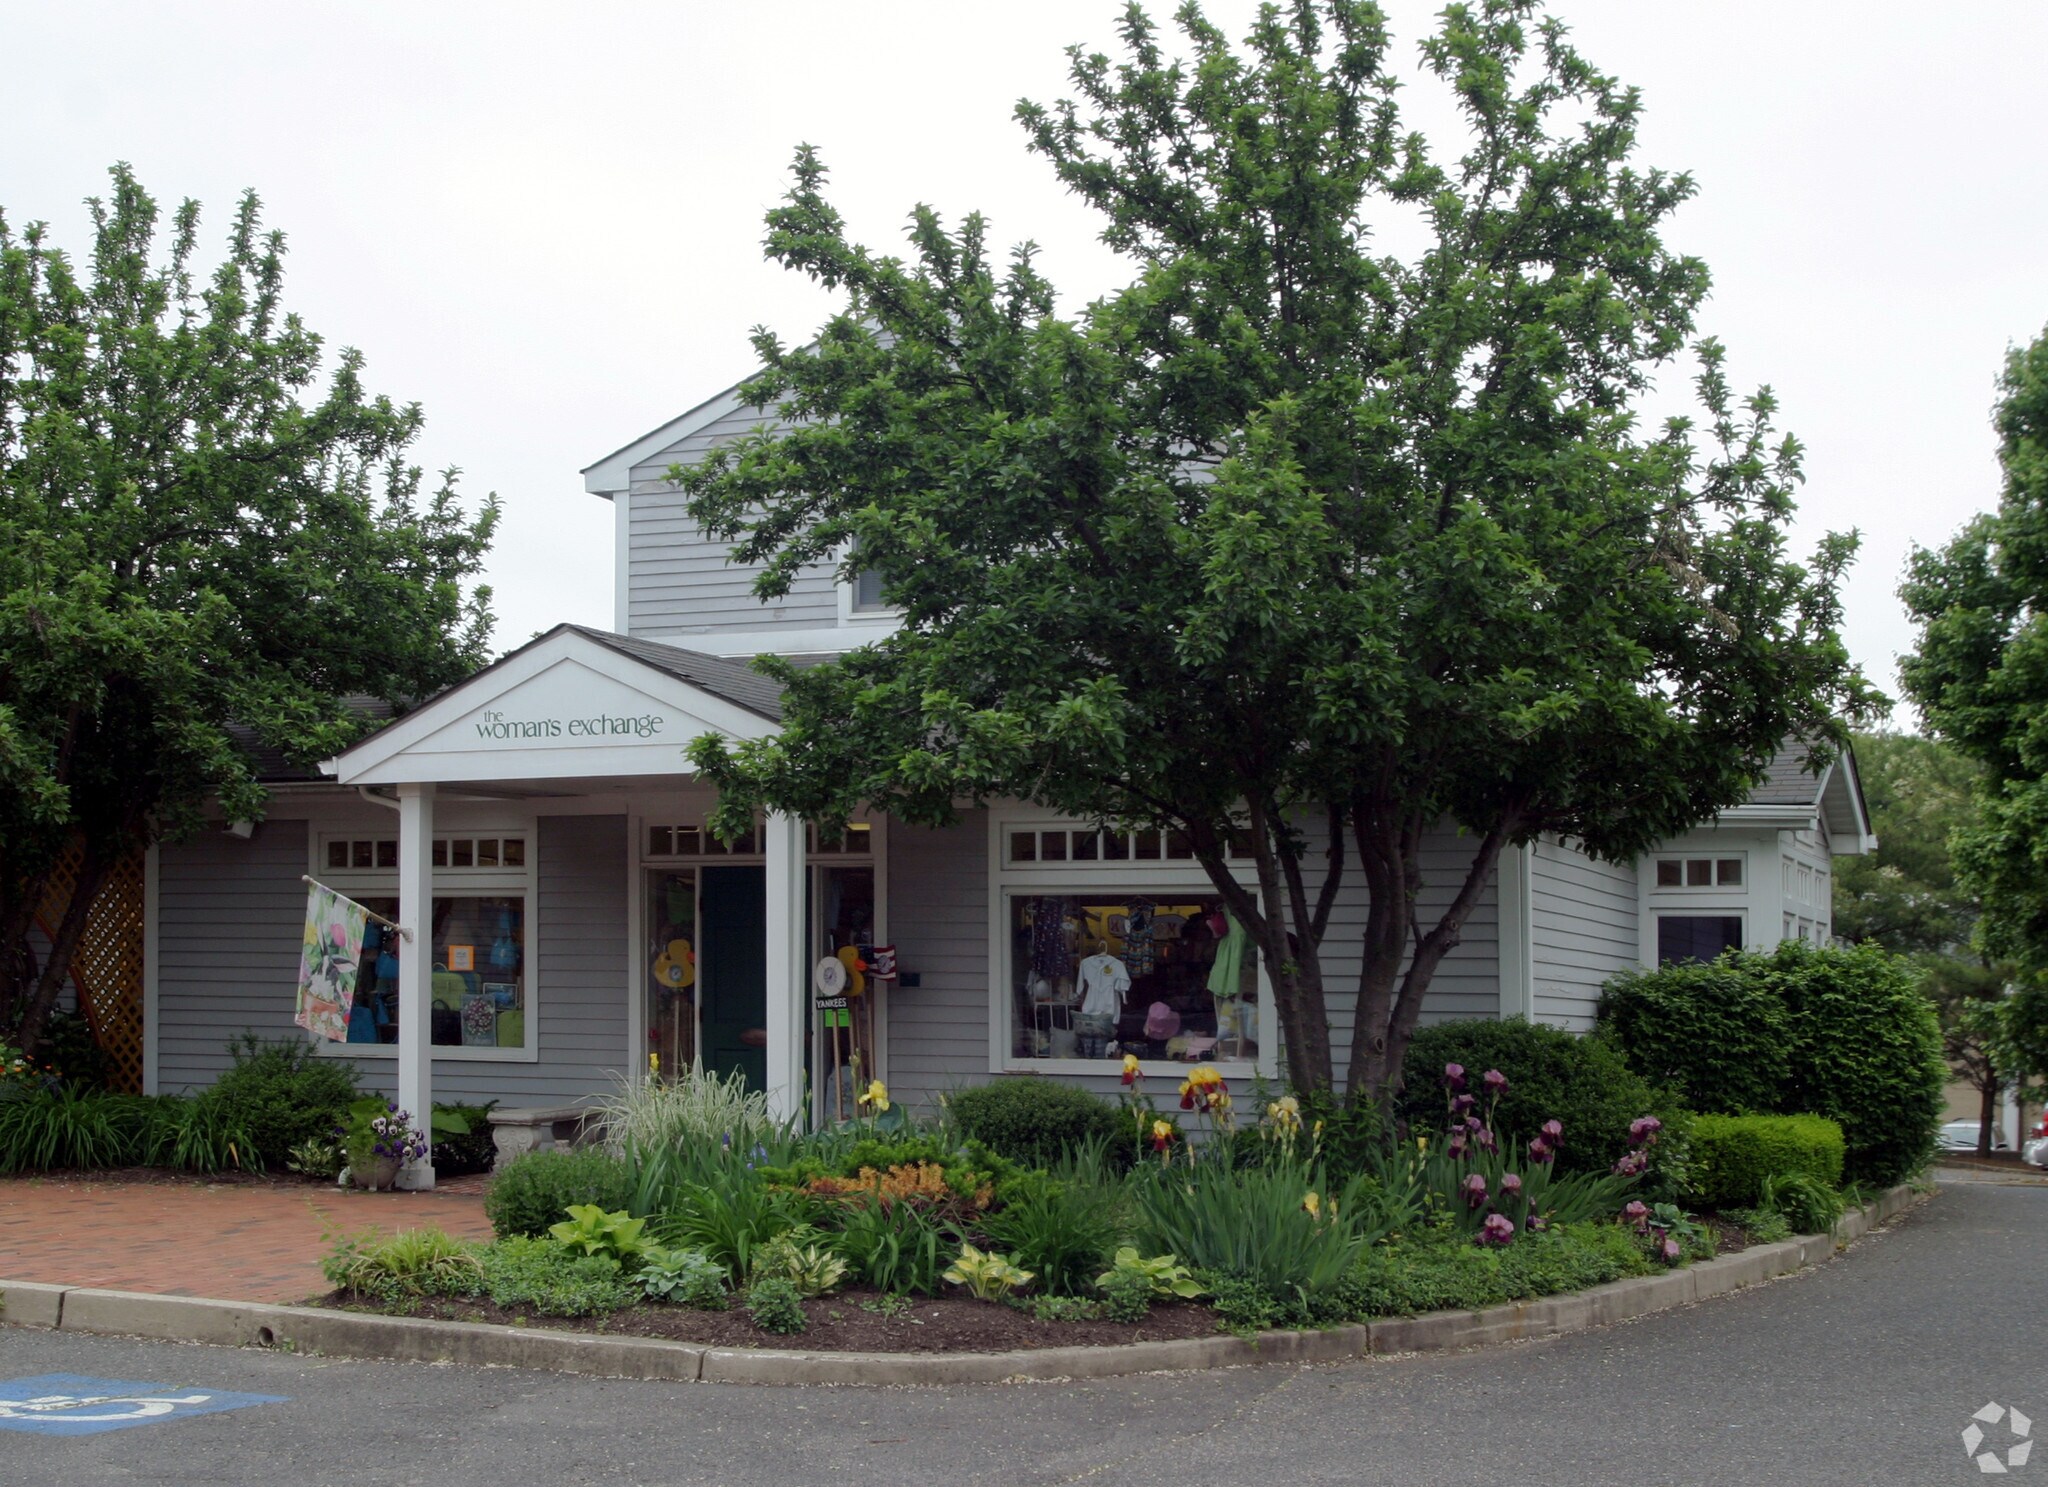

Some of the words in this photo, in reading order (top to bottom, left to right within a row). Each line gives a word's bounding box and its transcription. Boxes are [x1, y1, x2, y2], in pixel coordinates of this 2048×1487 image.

[484, 710, 504, 722] the
[476, 719, 562, 739] woman's
[568, 714, 664, 738] exchange
[816, 998, 847, 1008] YANKEES
